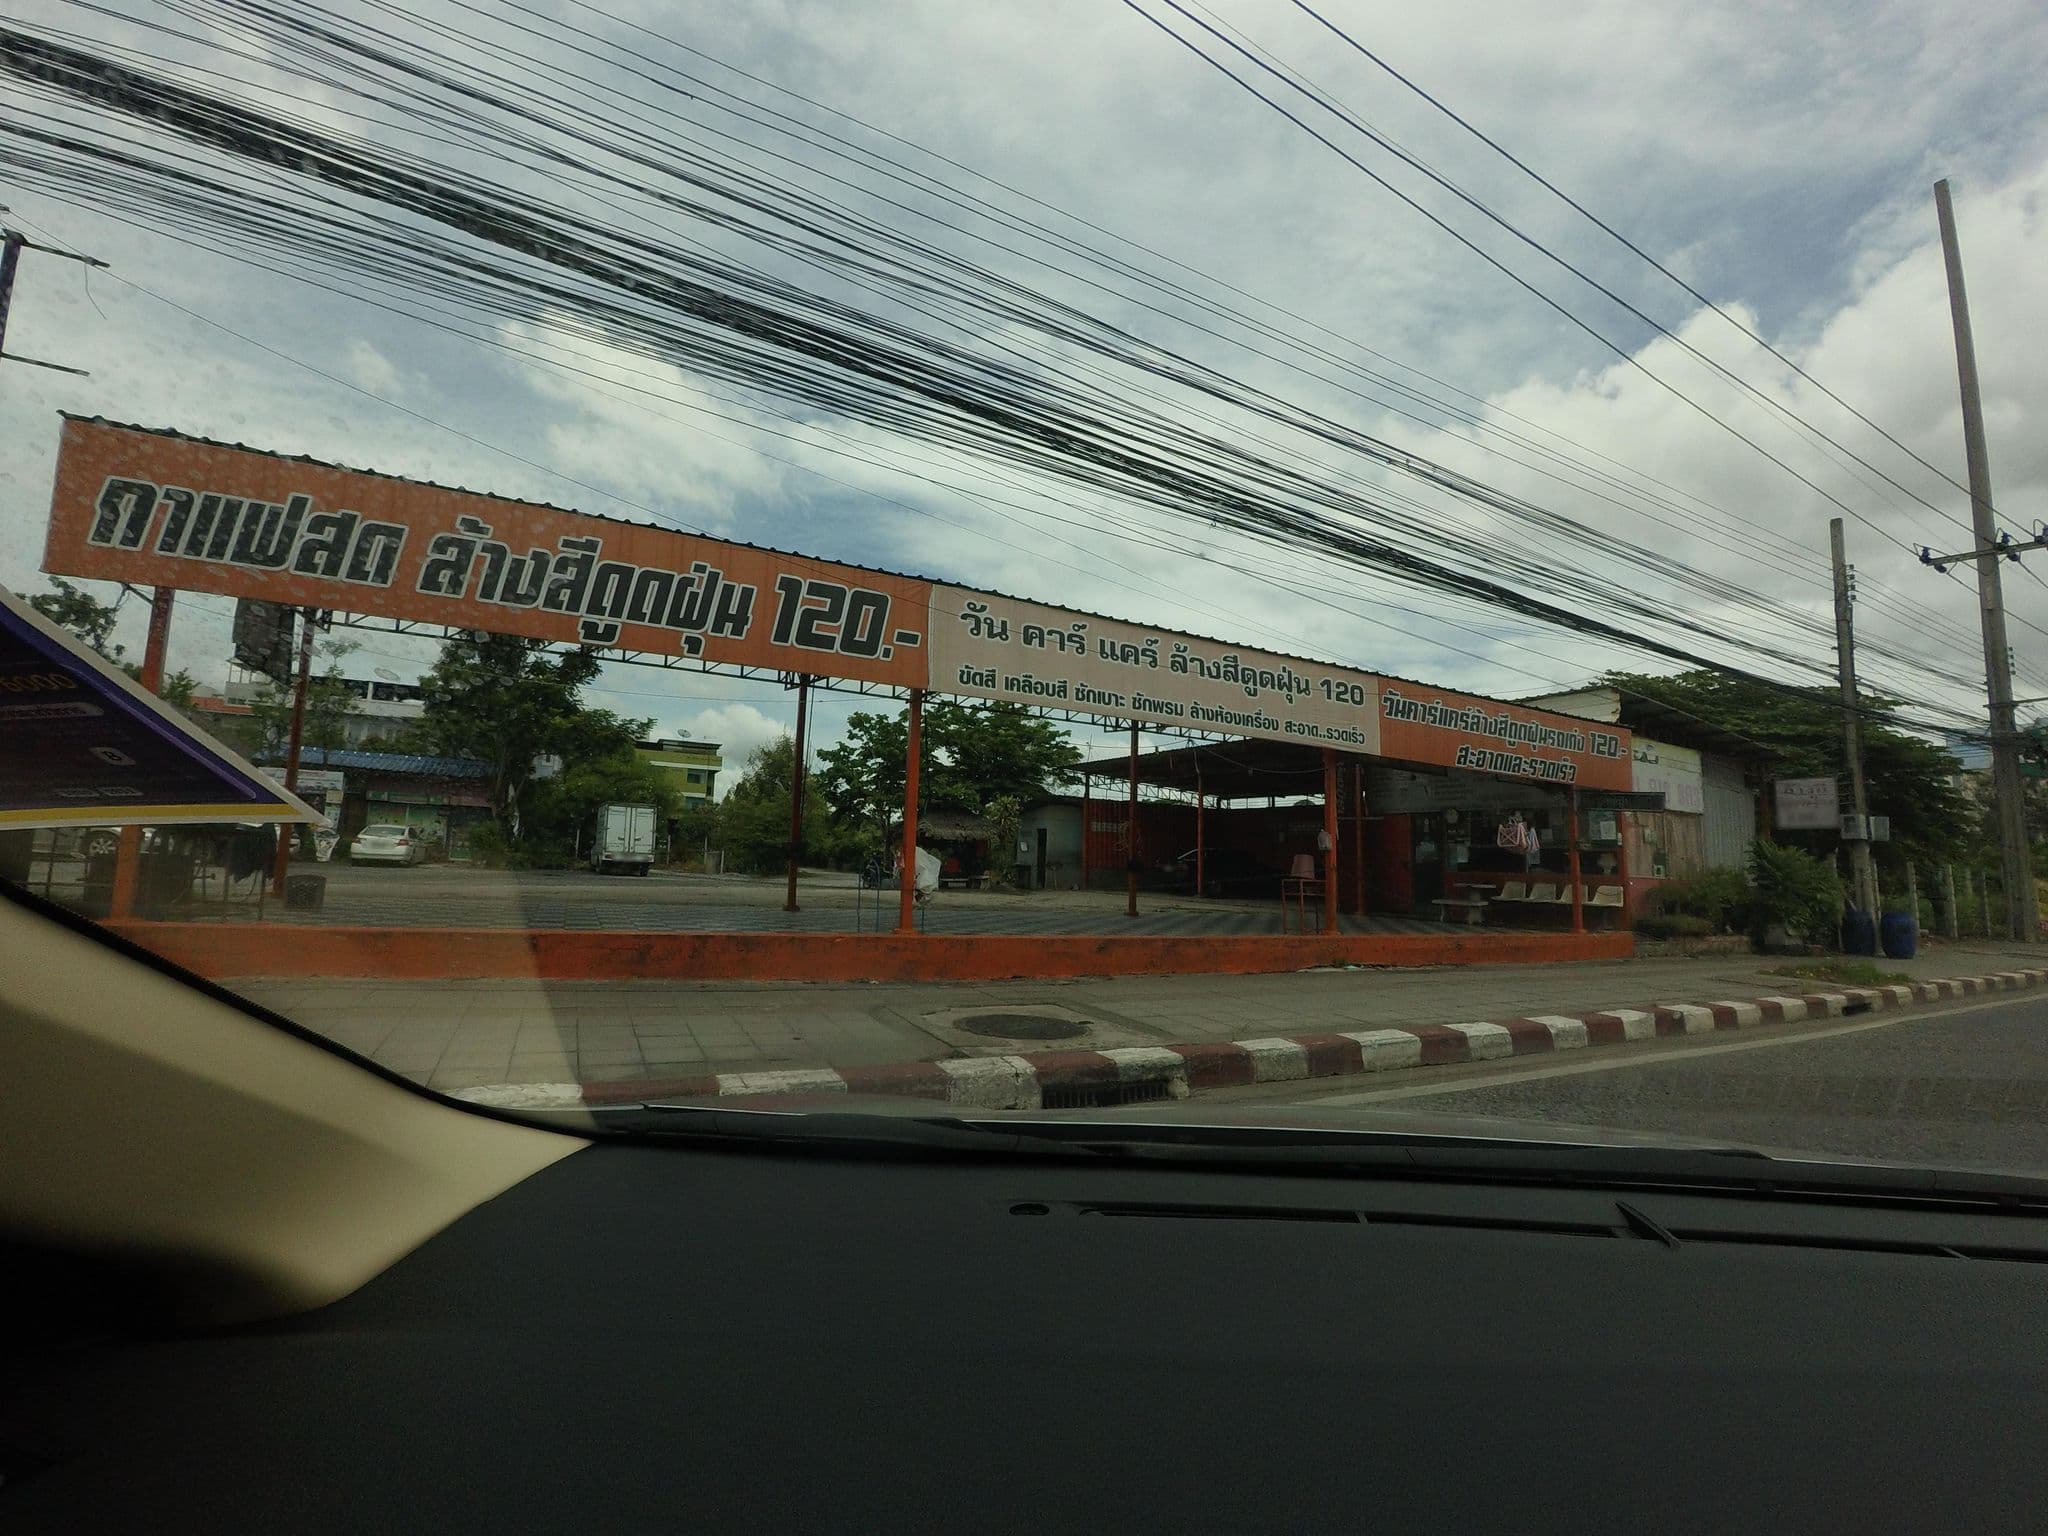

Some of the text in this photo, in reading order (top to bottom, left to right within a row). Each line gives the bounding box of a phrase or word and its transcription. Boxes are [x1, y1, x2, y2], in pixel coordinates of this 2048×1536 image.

[87, 475, 921, 660] กาแฟสด ล้างสีดูดฝุ่น 120.-
[959, 601, 1365, 706] วัน คาร์ แคร์ ล้างสีดูดฝุ่น 120
[958, 664, 997, 689] ขัดสี
[1003, 674, 1068, 700] เคลือบสี
[1074, 682, 1126, 708] ซักเบาะ
[1131, 692, 1184, 717] ซักพรม
[1189, 701, 1280, 731] ล้างห้องเครื่อง
[1455, 745, 1577, 783] สะอาดและรวดเร็ว
[1589, 731, 1629, 759] 120.-
